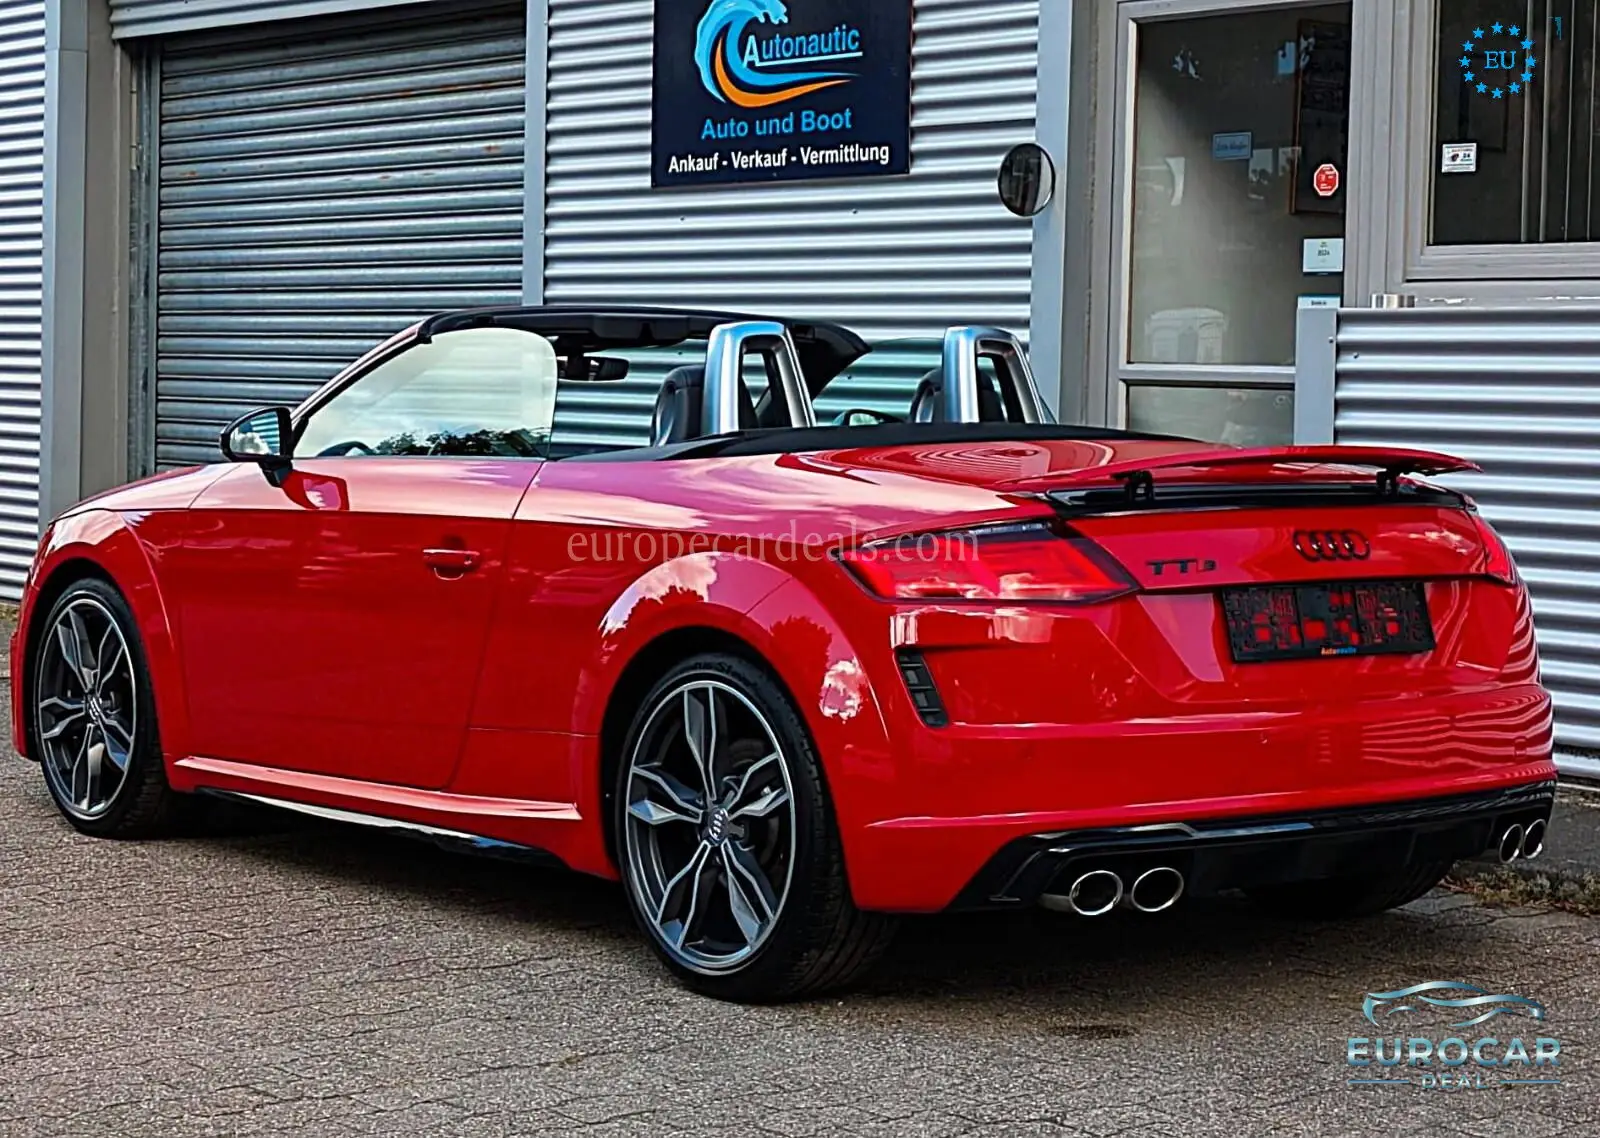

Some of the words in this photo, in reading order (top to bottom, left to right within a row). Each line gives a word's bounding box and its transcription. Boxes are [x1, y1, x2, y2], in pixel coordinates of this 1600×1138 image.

[744, 24, 861, 68] Autonautic
[702, 118, 748, 139] Auto
[756, 113, 793, 134] und
[801, 108, 852, 131] Boot
[669, 153, 719, 173] Ankauf
[732, 149, 788, 168] Verkauf
[801, 144, 889, 165] Vermittlung
